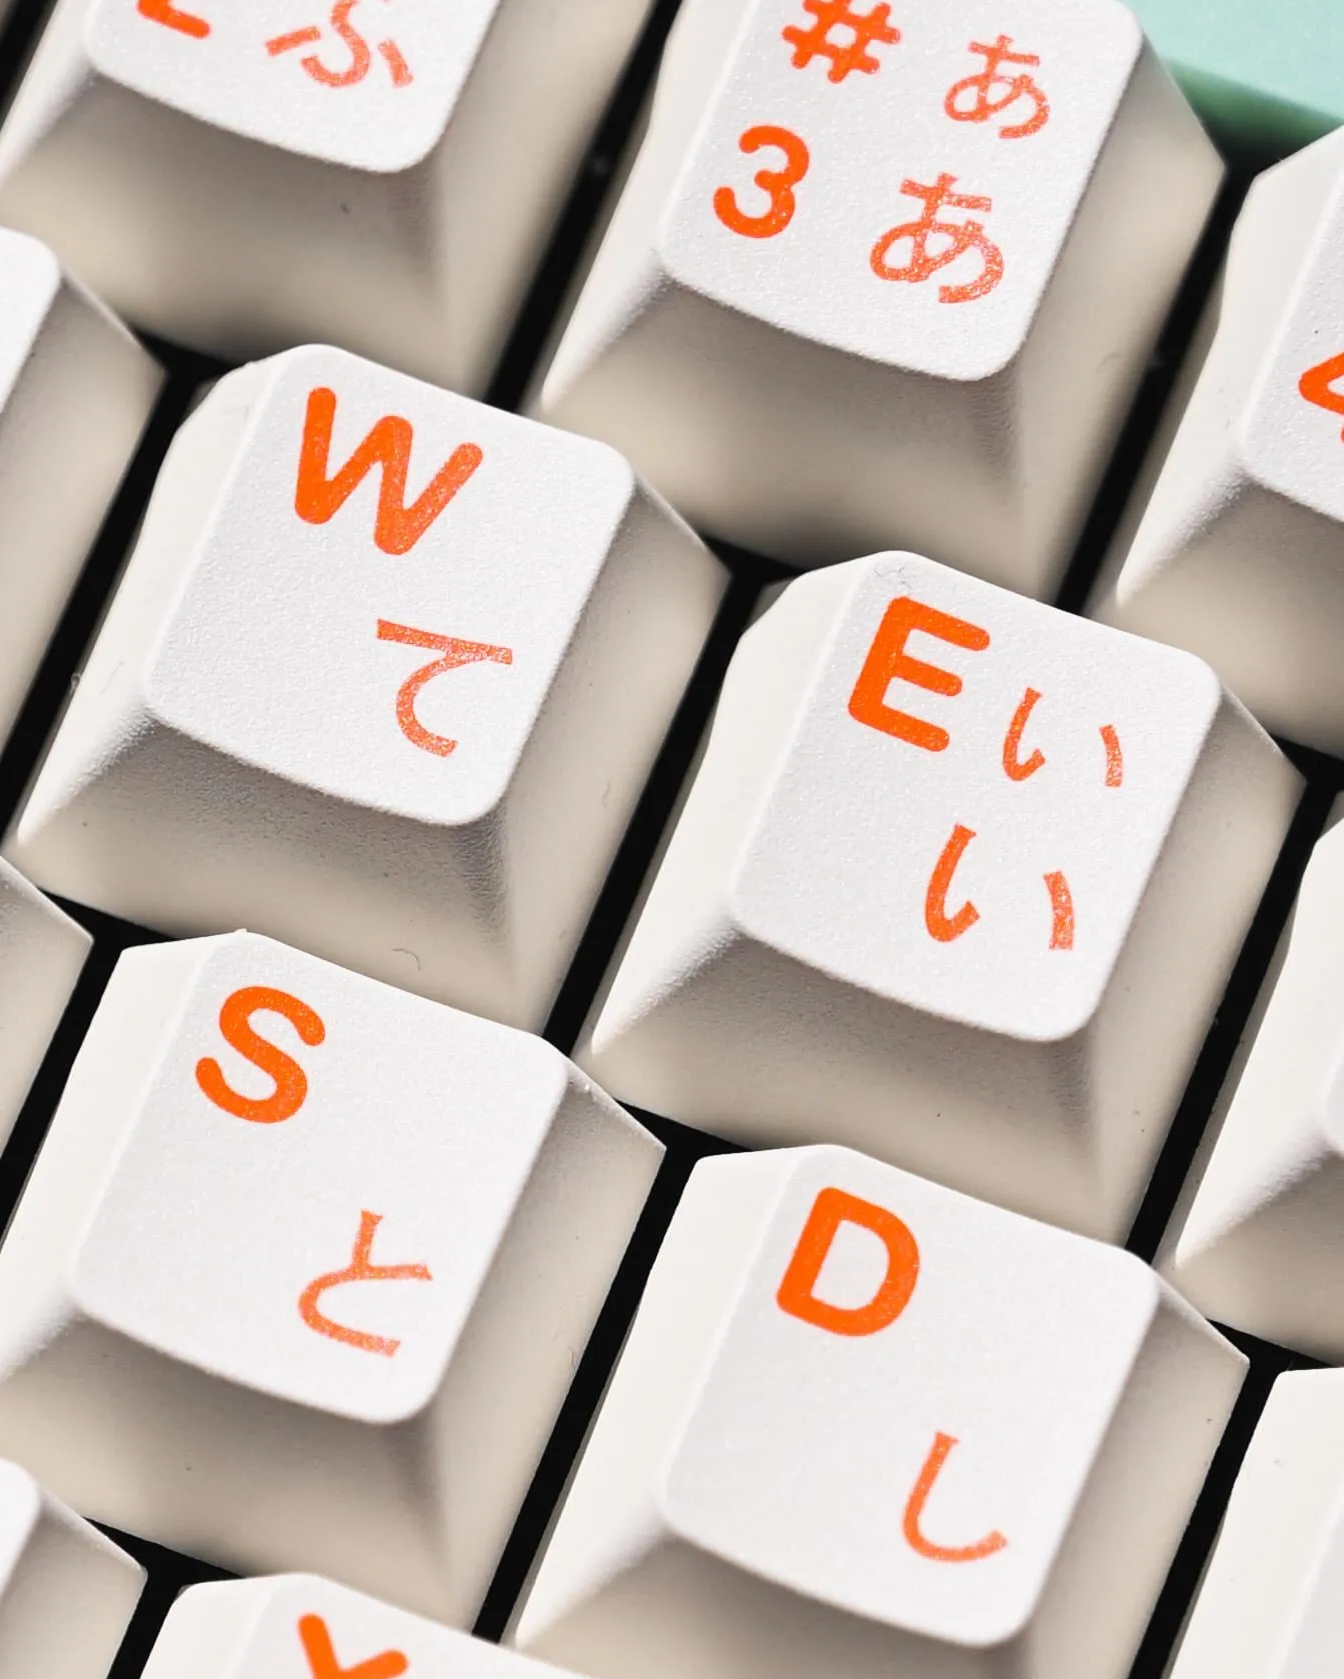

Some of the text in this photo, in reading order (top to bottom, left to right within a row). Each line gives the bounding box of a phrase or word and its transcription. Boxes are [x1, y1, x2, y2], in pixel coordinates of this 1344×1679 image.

[711, 122, 812, 241] 3
[868, 171, 1005, 305] あ
[292, 384, 485, 558] W
[375, 617, 514, 758] て
[846, 594, 993, 754] E
[922, 822, 1076, 951] い
[193, 983, 327, 1126] S
[296, 1208, 433, 1358] と
[773, 1184, 923, 1339] D
[900, 1430, 1008, 1564] し
